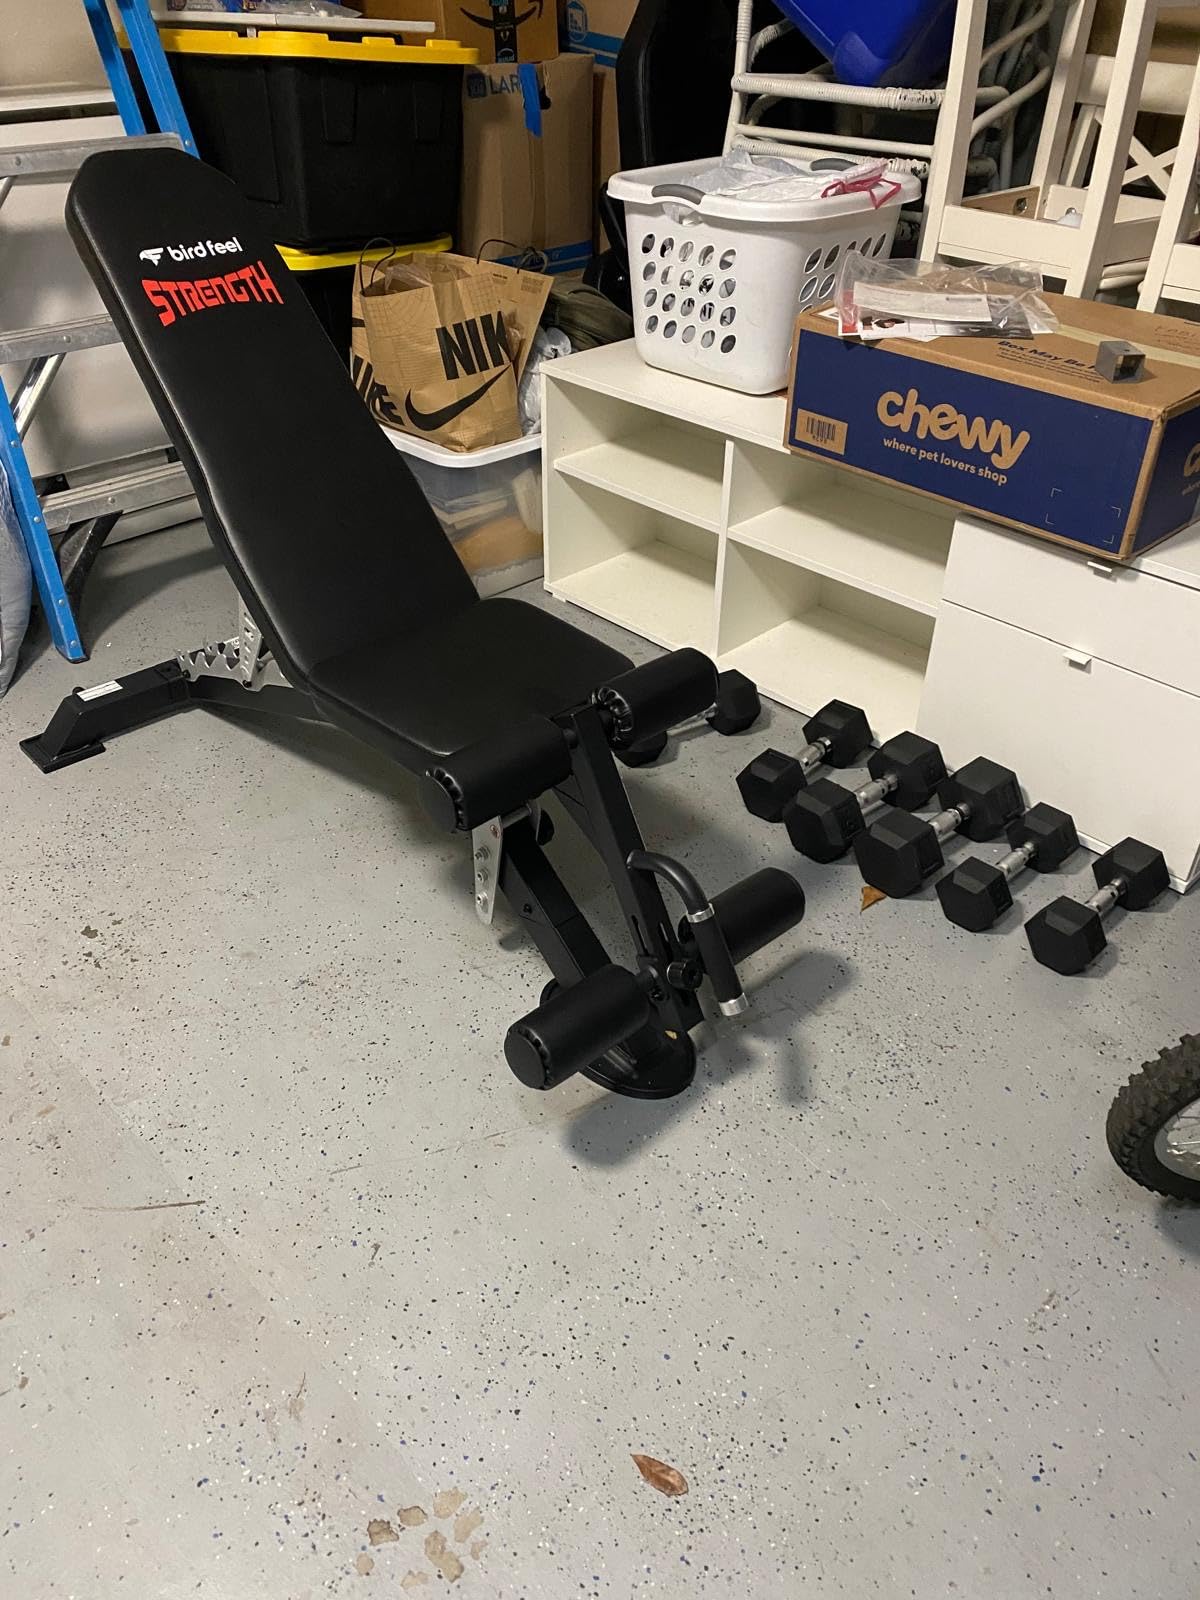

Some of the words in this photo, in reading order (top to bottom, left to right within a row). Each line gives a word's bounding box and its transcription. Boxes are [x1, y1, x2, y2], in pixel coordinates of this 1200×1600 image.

[489, 75, 522, 95] LAR
[141, 260, 285, 327] STRENGTH
[436, 310, 513, 381] NIK
[997, 340, 1027, 351] Box
[1028, 349, 1063, 361] May
[1064, 359, 1086, 367] Be
[876, 388, 1031, 470] chewy
[883, 437, 918, 456] where
[918, 449, 939, 461] pet
[940, 452, 976, 474] lovers
[977, 466, 1008, 486] shop
